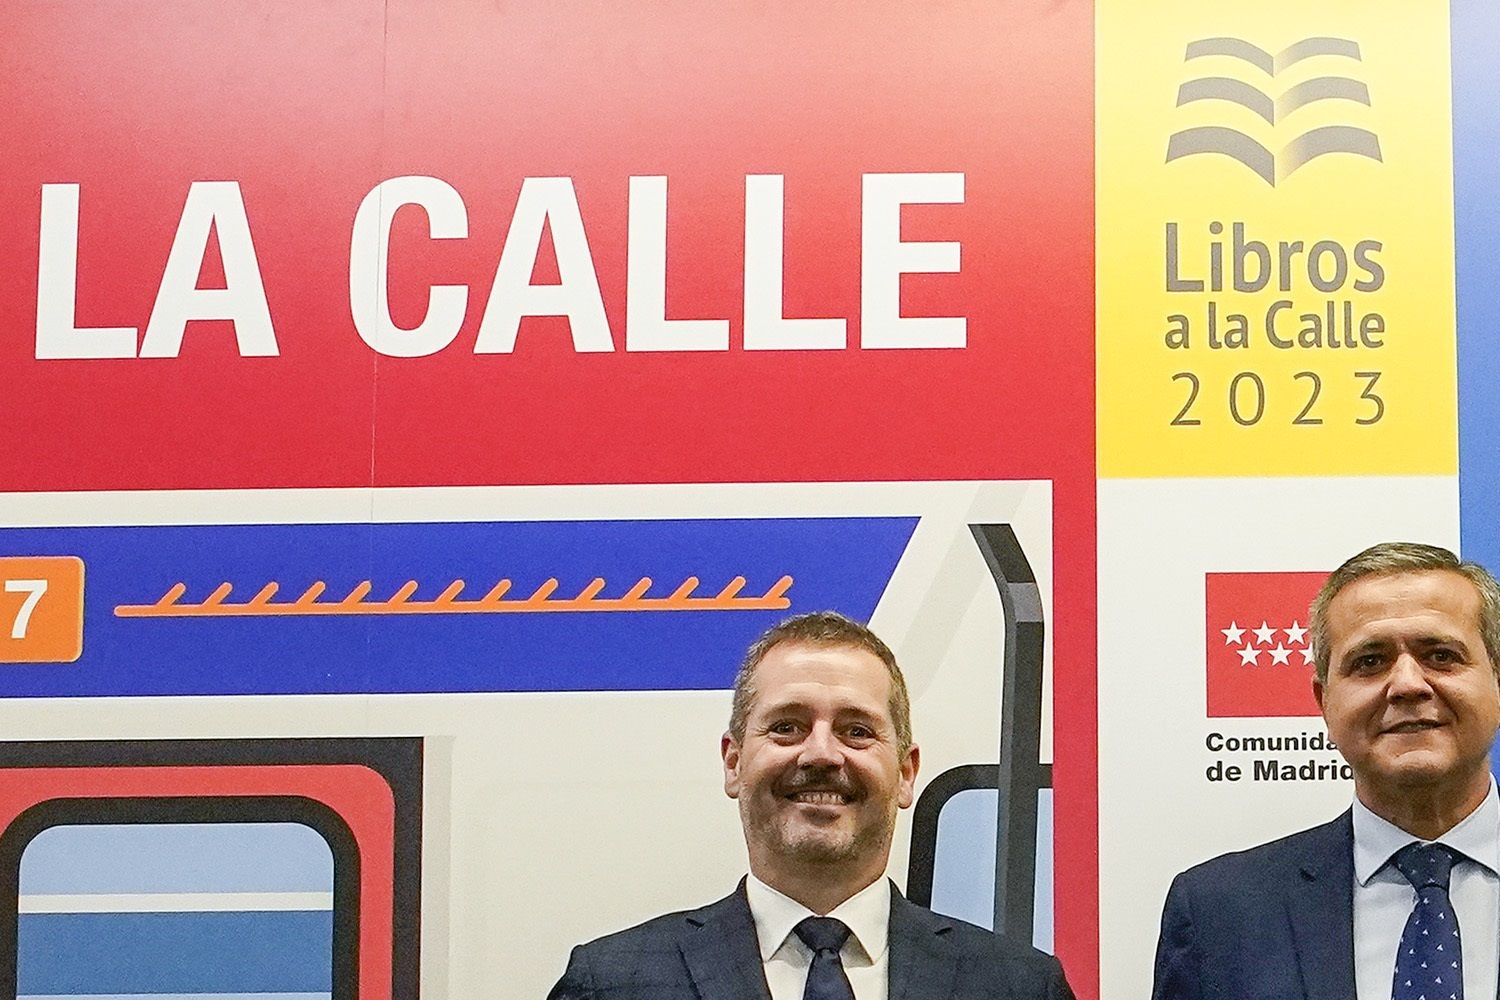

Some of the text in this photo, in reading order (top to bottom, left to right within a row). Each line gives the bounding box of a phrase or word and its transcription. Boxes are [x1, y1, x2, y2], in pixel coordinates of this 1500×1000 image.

[35, 172, 969, 359] LA CALLE
[1164, 220, 1386, 293] Libros
[1165, 301, 1386, 349] a la Calle
[1170, 371, 1386, 427] 2023
[3, 580, 47, 639] 7
[1206, 760, 1242, 782] de
